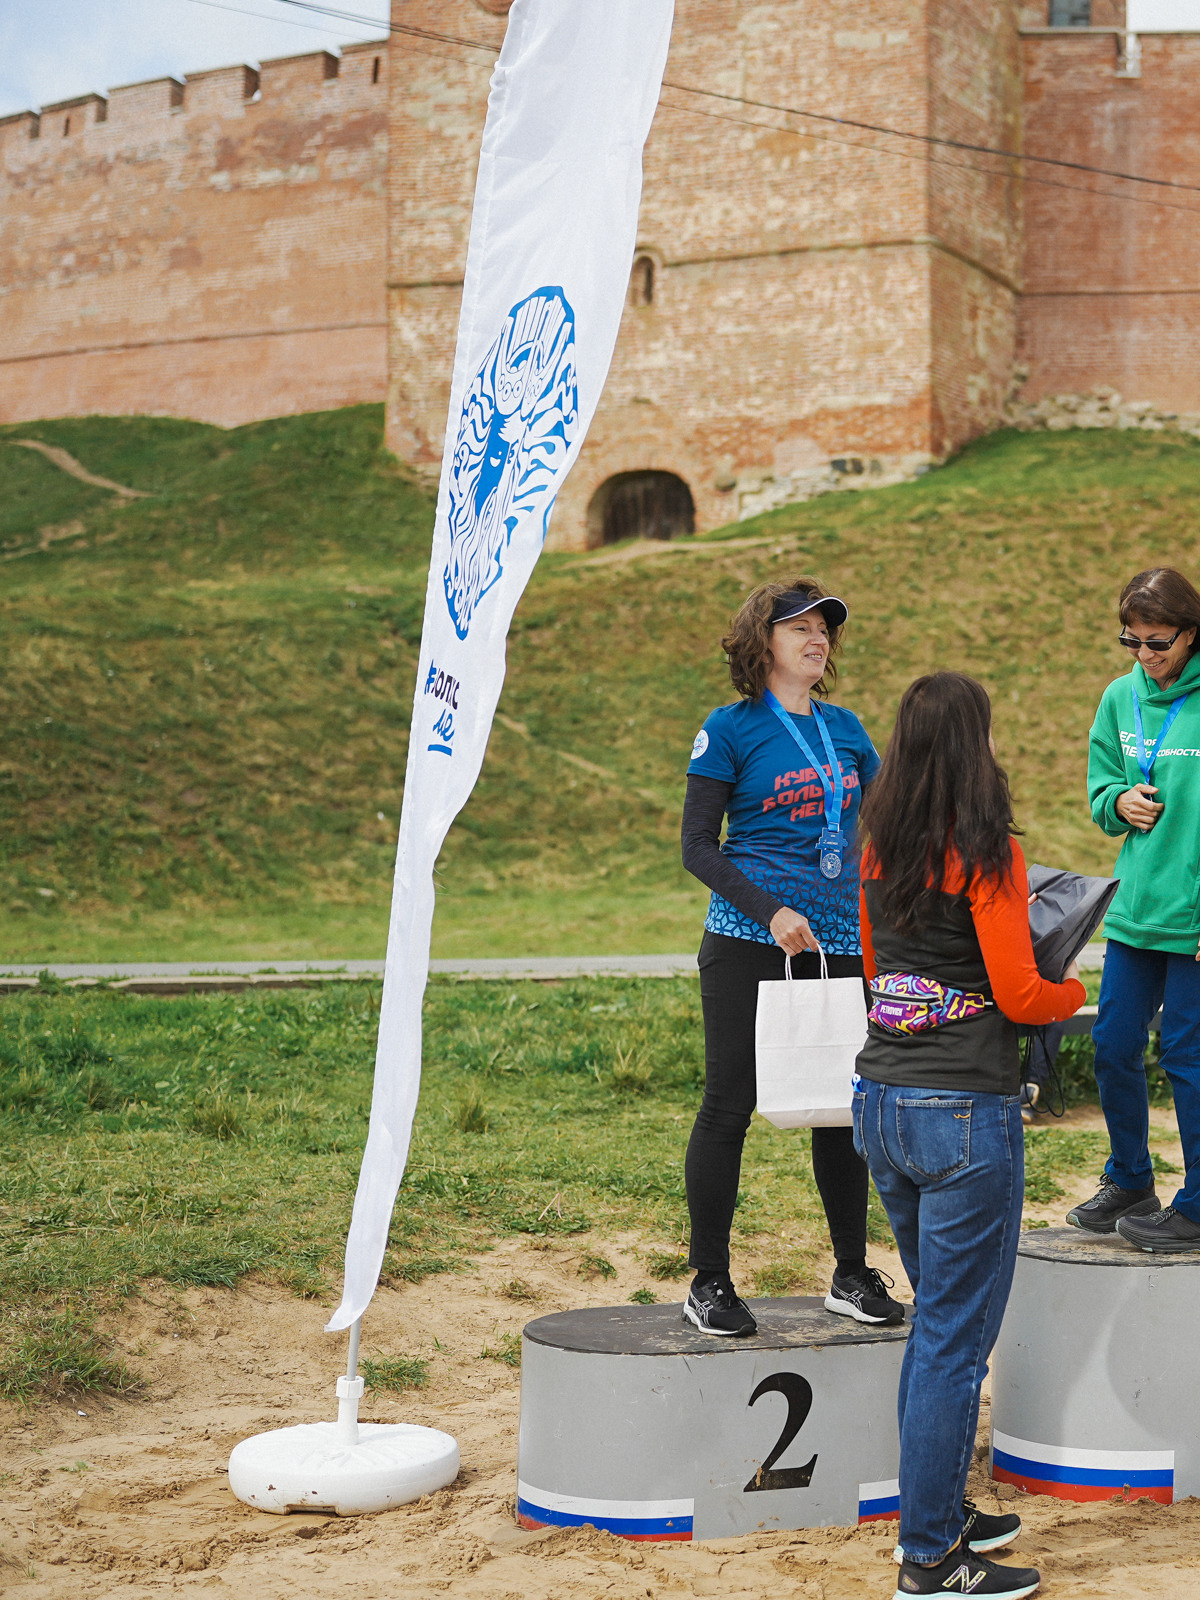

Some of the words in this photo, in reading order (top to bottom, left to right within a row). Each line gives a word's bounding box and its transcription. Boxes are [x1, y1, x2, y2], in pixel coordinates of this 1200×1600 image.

[1119, 729, 1136, 743] ЕГ
[763, 770, 859, 813] БОЛЬОЙ
[743, 1371, 818, 1492] 2
